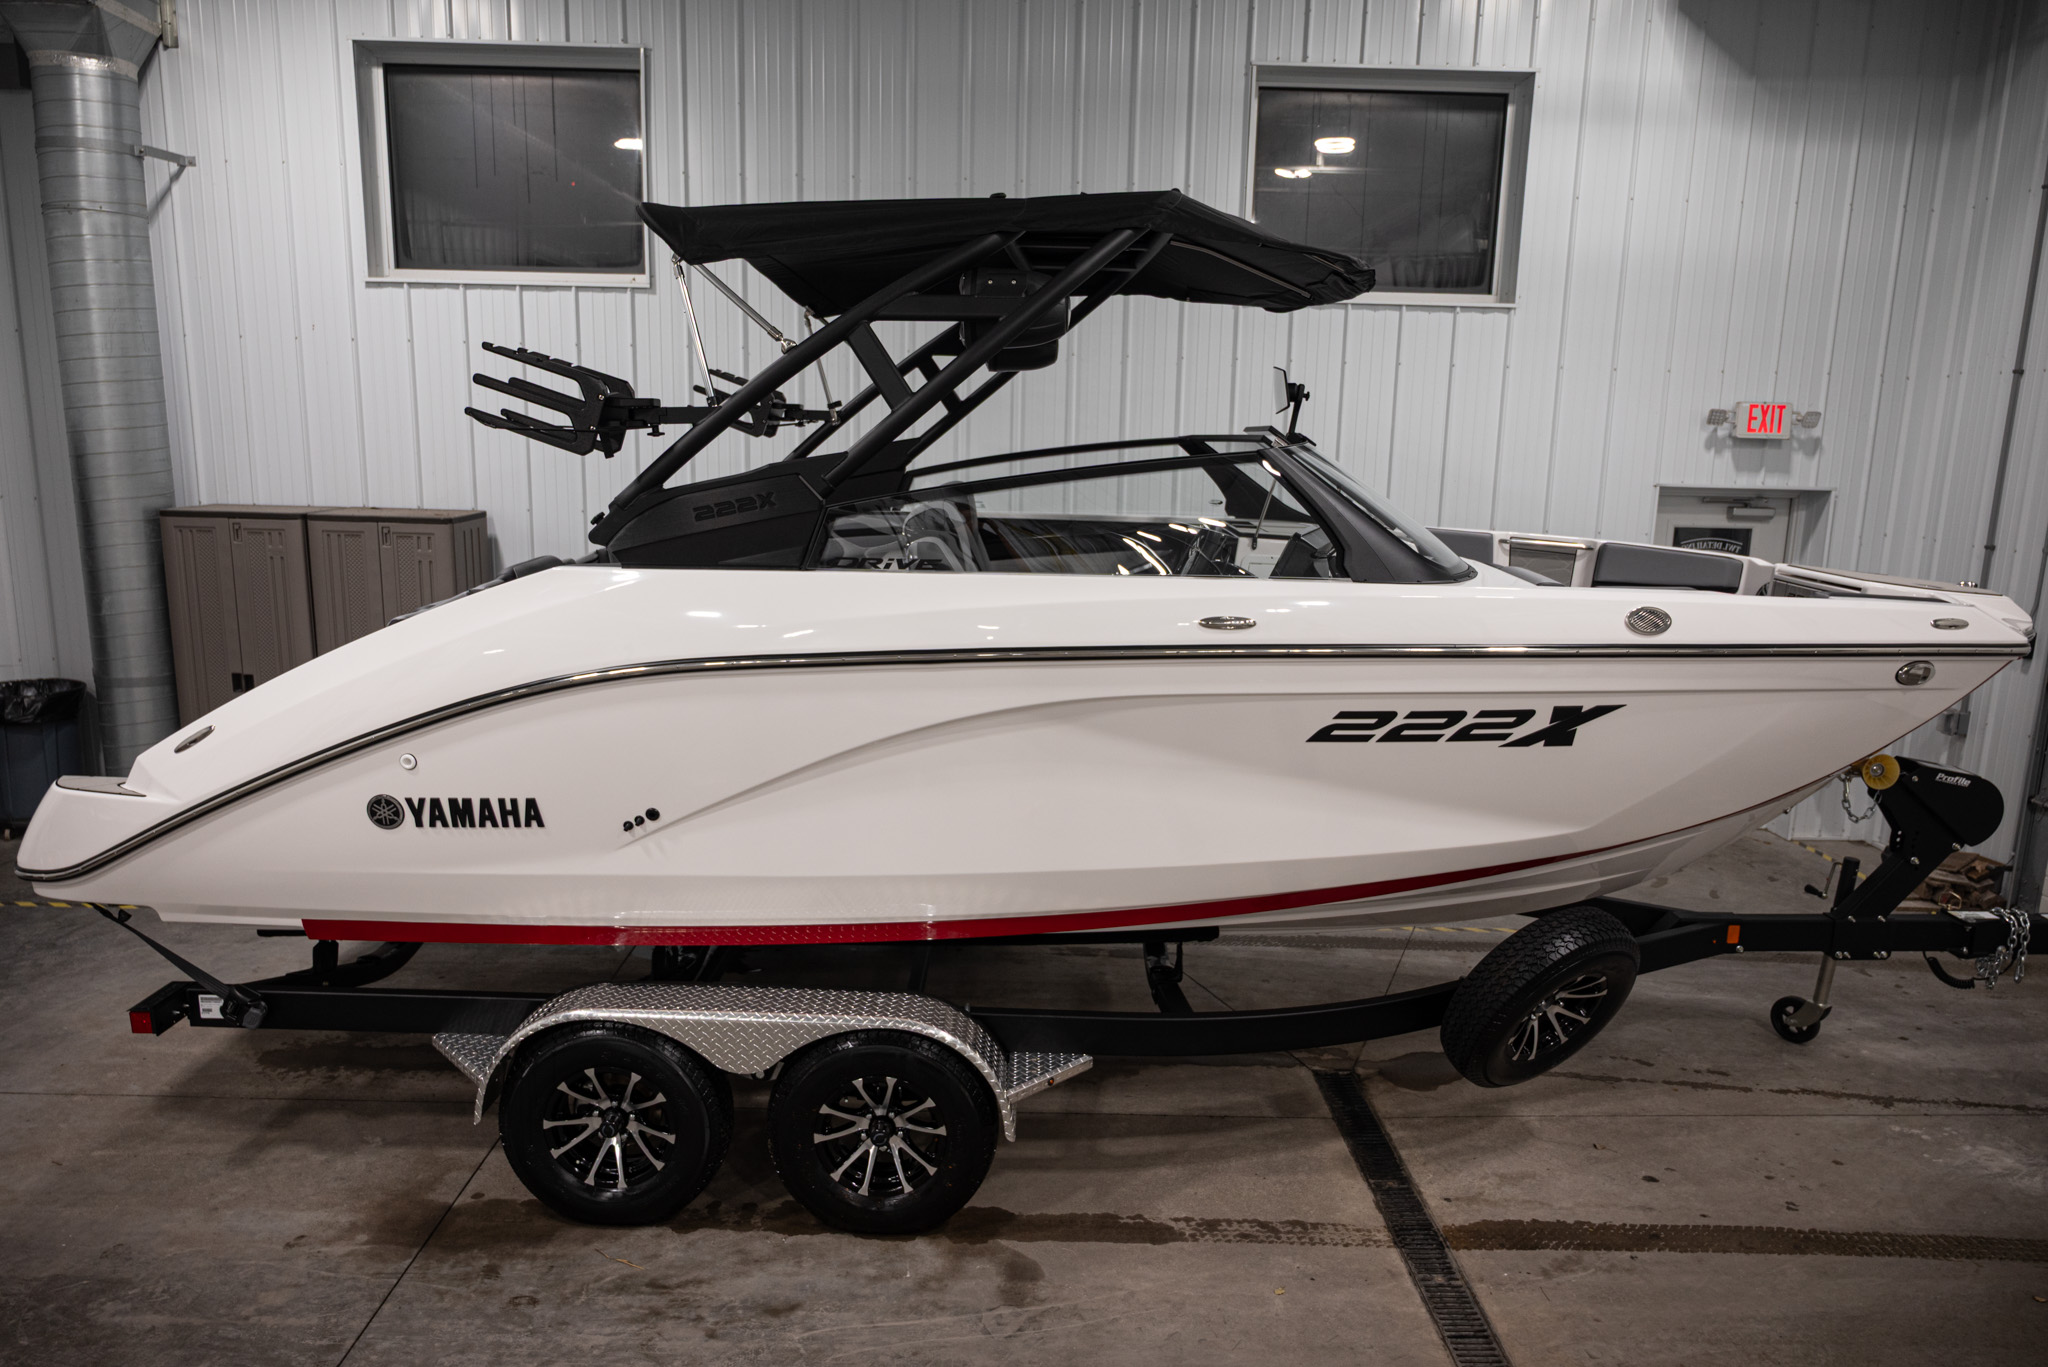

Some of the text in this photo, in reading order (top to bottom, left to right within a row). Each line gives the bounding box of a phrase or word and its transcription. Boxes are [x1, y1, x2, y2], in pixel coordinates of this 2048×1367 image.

[1746, 404, 1787, 434] EXIT
[692, 491, 777, 522] 222X
[1305, 704, 1628, 748] 222X
[1935, 772, 1971, 786] Profile
[404, 797, 546, 828] YAMAHA
